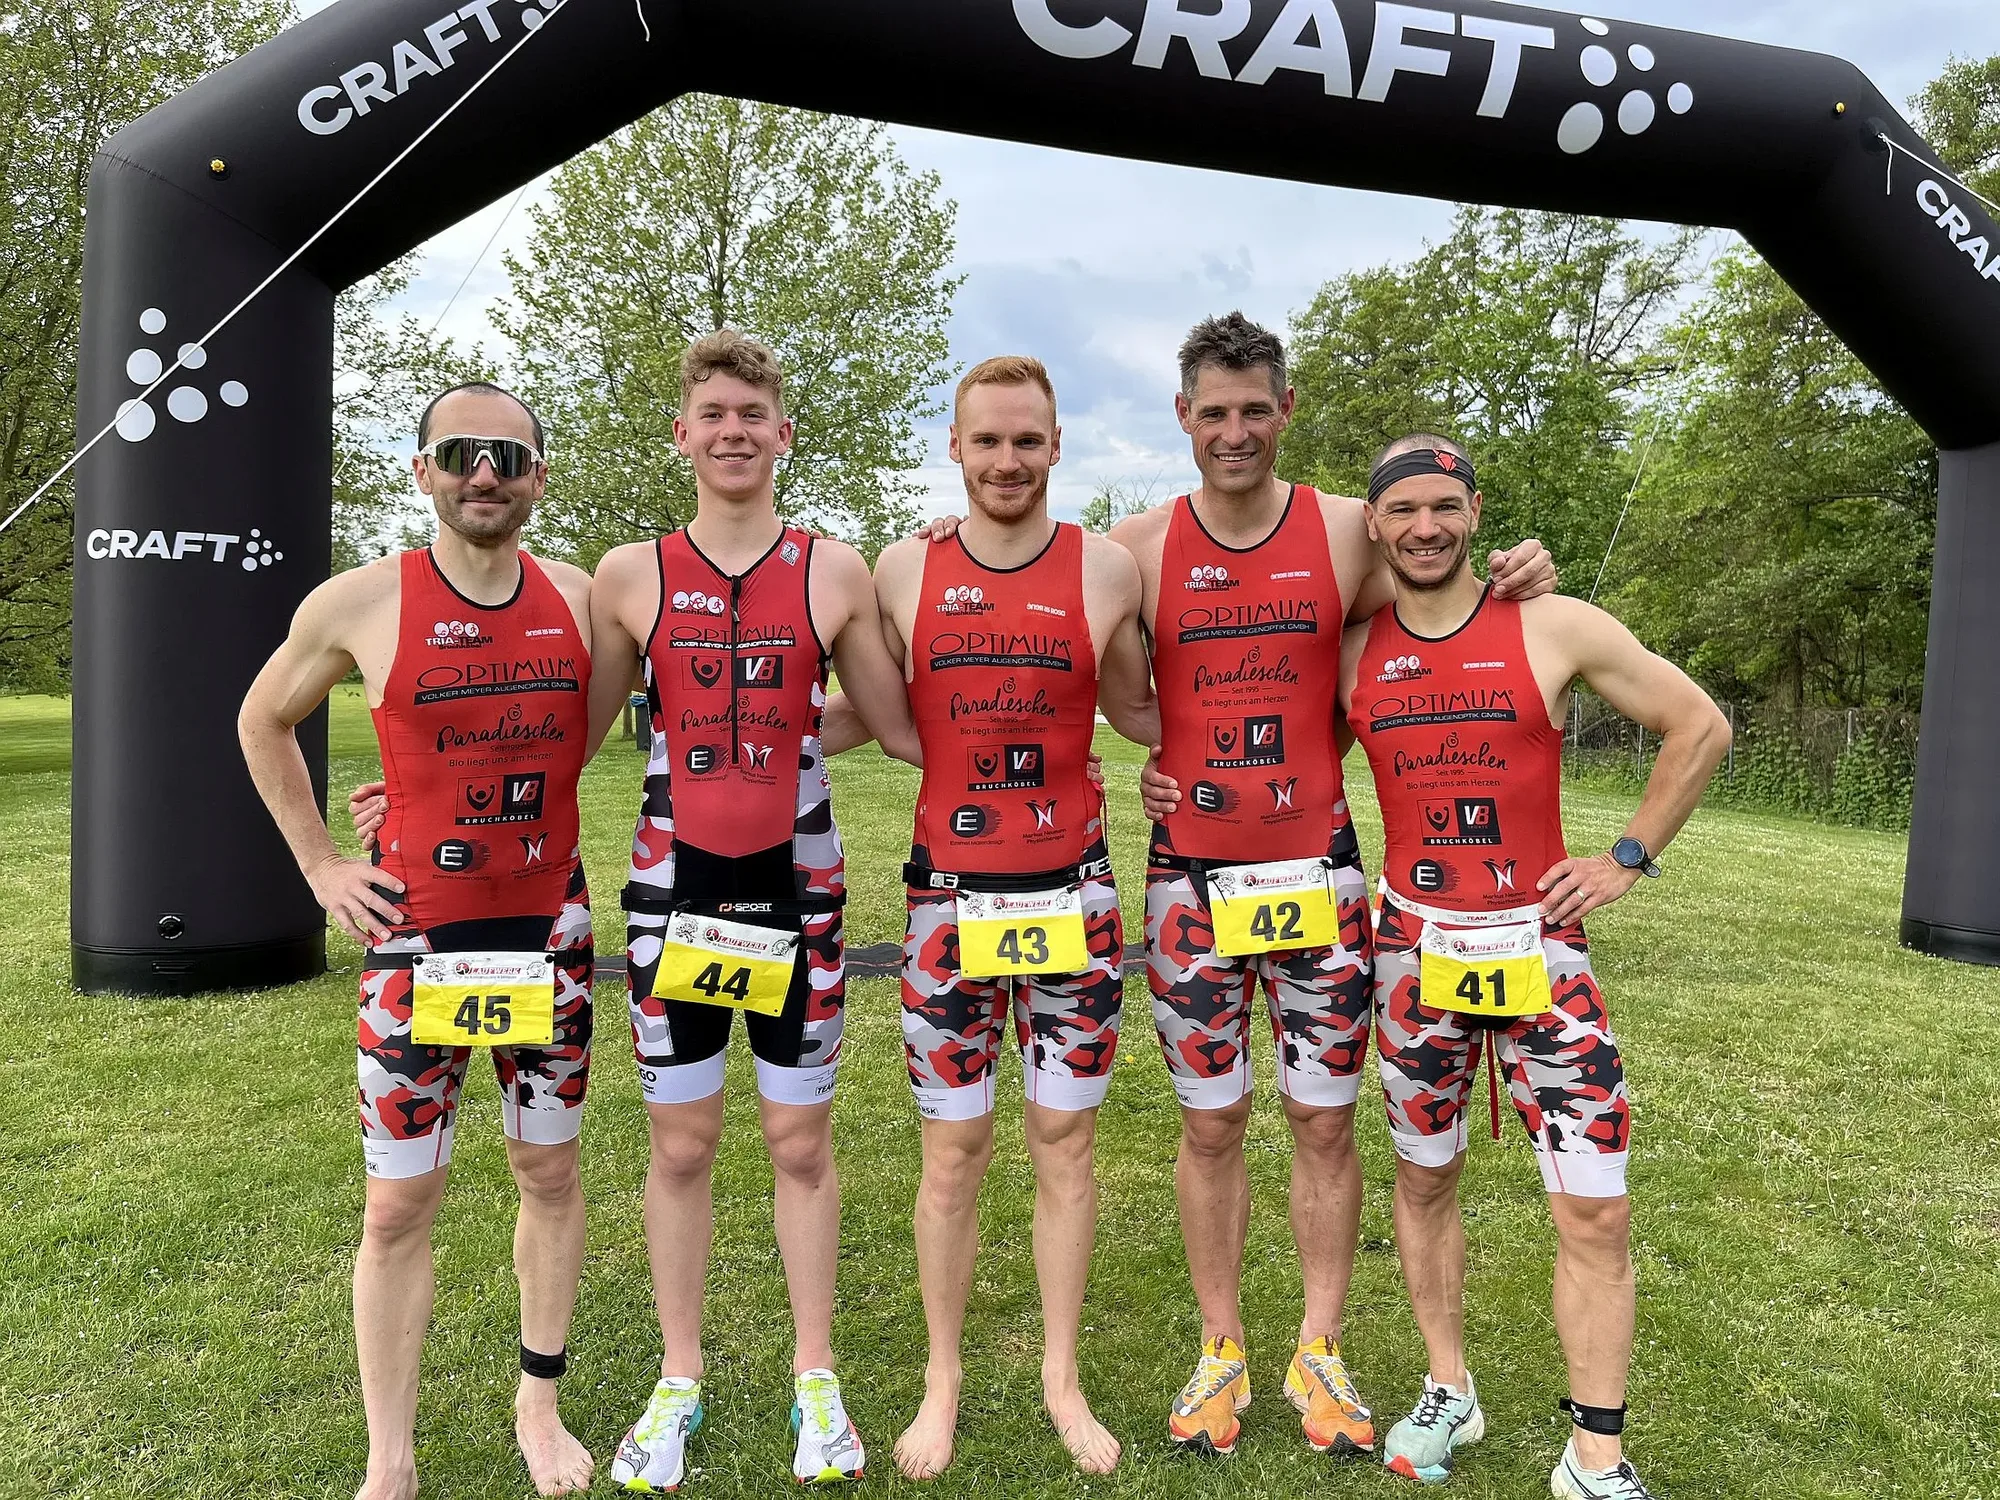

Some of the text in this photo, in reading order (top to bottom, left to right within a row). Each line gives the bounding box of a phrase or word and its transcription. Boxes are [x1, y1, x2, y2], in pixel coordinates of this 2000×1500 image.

[298, 0, 503, 135] CRAFT
[1013, 0, 1556, 119] CRAFT
[86, 528, 241, 563] CRAFT
[1183, 579, 1240, 589] TRIA-TEAM
[935, 602, 995, 613] TRIA-TEAM
[1182, 623, 1310, 640] VOLKER MEYER AUGENOPTIK GMBH
[425, 635, 494, 646] TRIA-TEAM
[699, 642, 724, 650] MEYER
[934, 656, 1065, 668] VOLKER MEYER AUGENOPTIK GMBH
[1194, 654, 1299, 693] Paradieschen
[1376, 668, 1433, 682] TRIA-TEAM
[421, 681, 574, 701] VOLKER MEYER AUGENOPTIK GMBH
[1231, 685, 1260, 695] Seit 1995
[950, 687, 1057, 721] Paradieschen
[1201, 699, 1213, 708] Bio
[1214, 698, 1232, 709] liegt
[1233, 698, 1248, 706] uns
[1263, 695, 1290, 704] Herzen
[681, 704, 789, 733] Paradeschen
[1374, 711, 1507, 729] VOLKER MEYER AUGENOPTIK GMBH
[436, 712, 565, 753] Paradieschen
[960, 727, 971, 735] Bio
[972, 727, 990, 737] liegt
[992, 726, 1007, 734] uns
[1022, 726, 1048, 734] Herzen
[449, 752, 554, 768] Bio liegt uns am Herzen
[1213, 757, 1277, 767] BRUCHKÖBEL
[1394, 741, 1508, 777] Paradieschen
[1435, 768, 1465, 777] Seit 1995
[975, 781, 1037, 790] BRUCHKÖBEL
[1406, 782, 1418, 790] Bio
[1419, 780, 1439, 791] liegt
[1456, 779, 1469, 787] am
[1470, 778, 1501, 787] Herzen
[1430, 837, 1493, 845] BRUCHKÖBEL
[1250, 901, 1304, 942] 42
[996, 926, 1050, 965] 43
[692, 961, 752, 1002] 44
[1455, 968, 1508, 1008] 41
[454, 994, 512, 1036] 45
